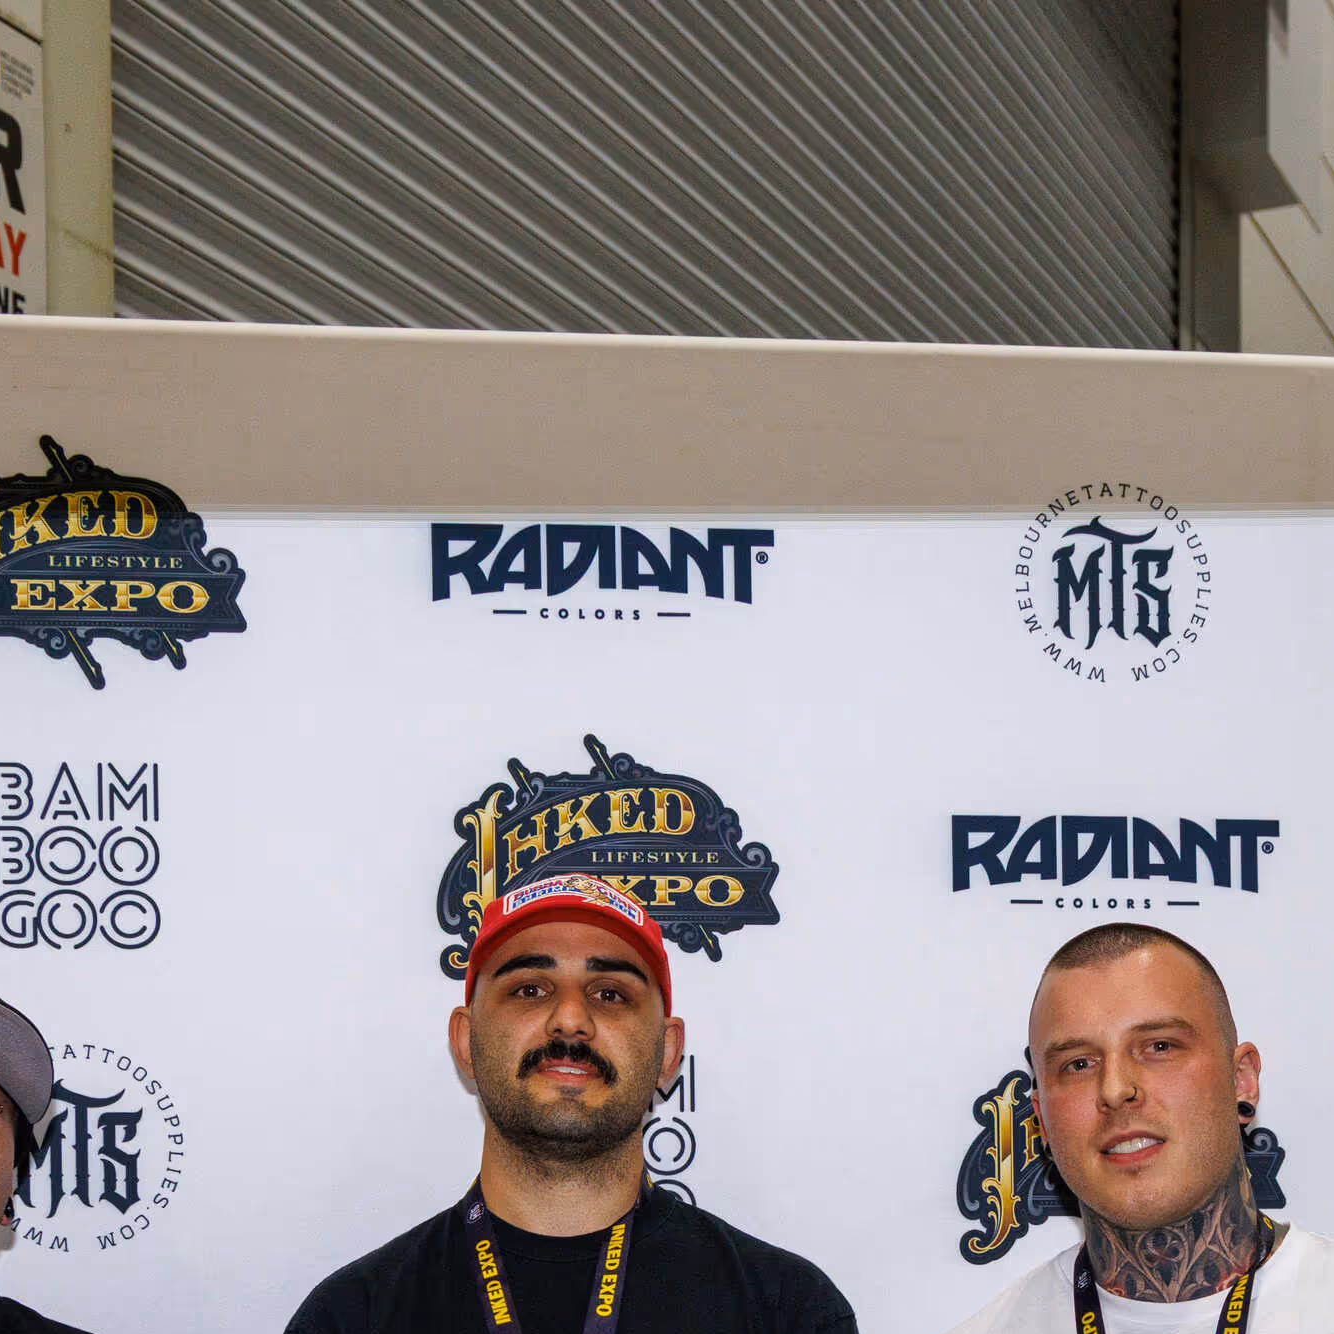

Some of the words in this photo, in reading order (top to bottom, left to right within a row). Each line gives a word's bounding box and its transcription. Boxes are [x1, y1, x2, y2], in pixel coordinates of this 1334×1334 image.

[48, 554, 183, 570] LIFESTYLE
[11, 579, 210, 613] EXPO
[1052, 515, 1174, 651] MTS
[540, 608, 639, 620] COLORS
[591, 851, 719, 864] LIFESTYLE
[599, 875, 745, 907] XPO
[1056, 898, 1150, 909] COLORS
[475, 1239, 498, 1279] EXPO
[604, 1223, 626, 1271] INKED
[486, 1279, 512, 1325] INKED
[595, 1274, 618, 1317] EXPO
[1226, 1274, 1249, 1323] INKED
